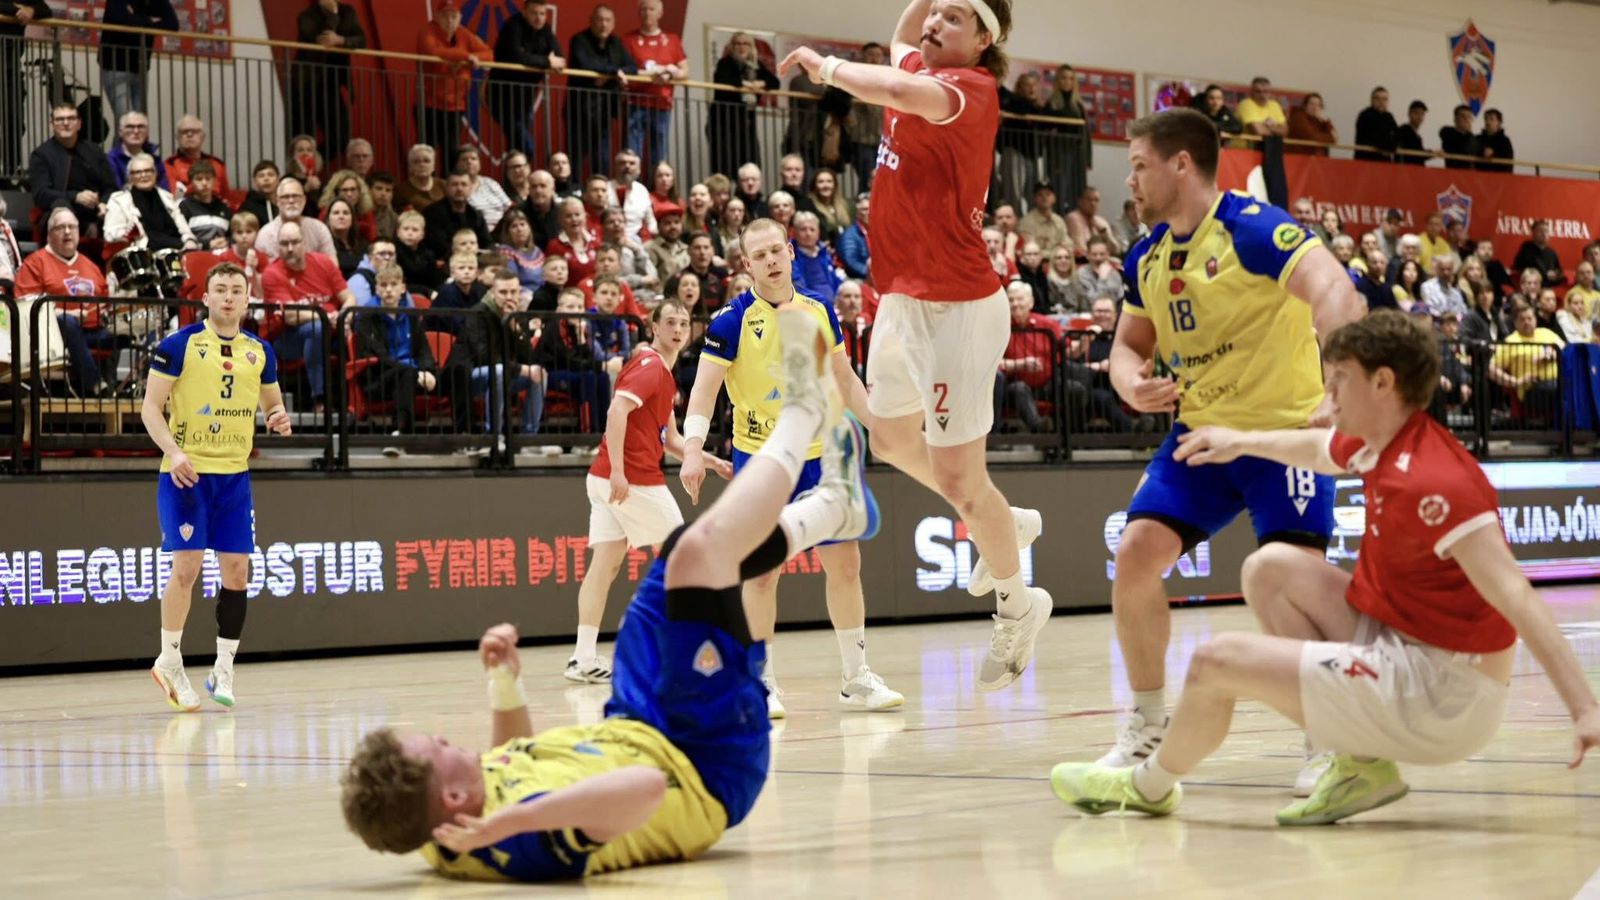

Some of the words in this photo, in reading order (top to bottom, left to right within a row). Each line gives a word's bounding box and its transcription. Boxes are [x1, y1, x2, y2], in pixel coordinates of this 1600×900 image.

[1168, 298, 1196, 333] 18
[220, 375, 234, 400] 3
[933, 383, 949, 413] 2
[214, 407, 252, 418] atnorth
[1285, 466, 1316, 498] 18
[395, 537, 517, 590] FYRIR
[1344, 658, 1379, 681] 4
